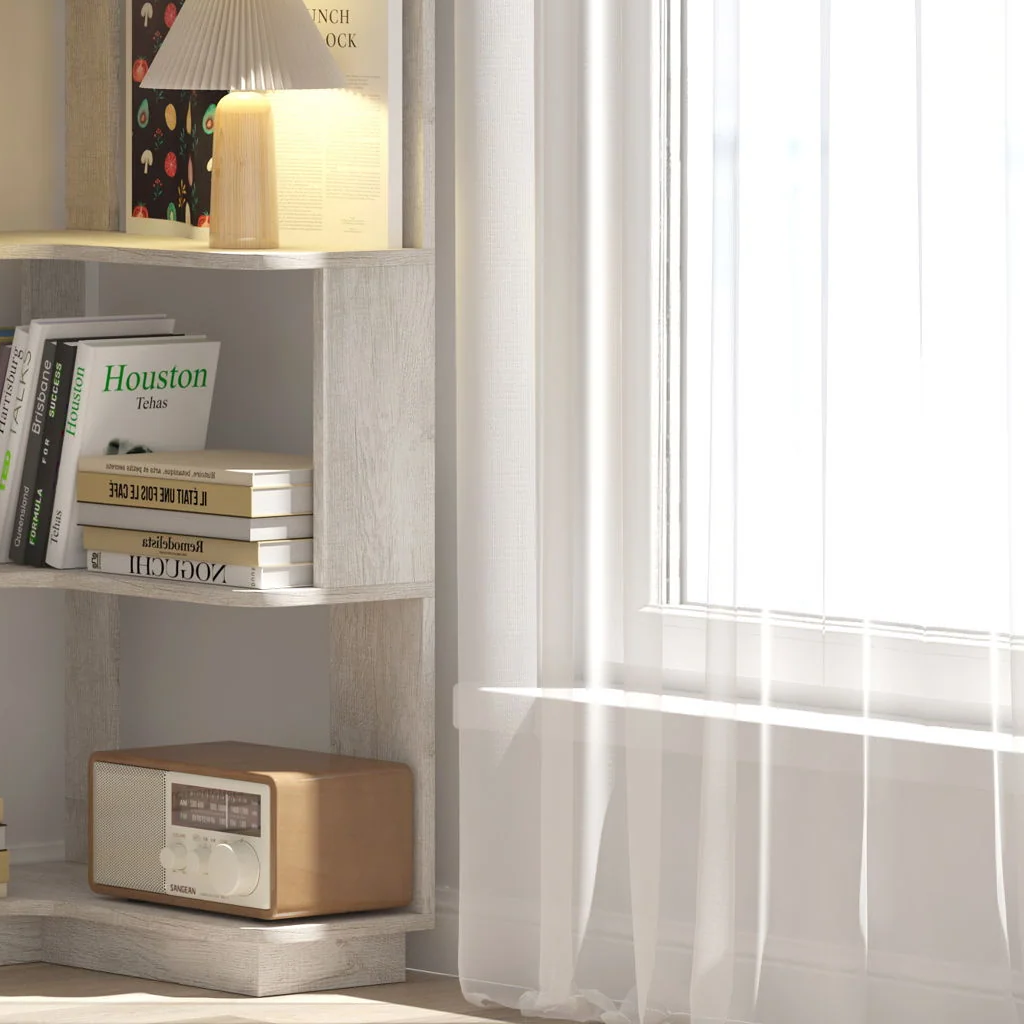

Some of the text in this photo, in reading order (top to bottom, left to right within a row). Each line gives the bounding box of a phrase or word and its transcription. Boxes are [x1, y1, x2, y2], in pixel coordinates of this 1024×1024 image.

[10, 350, 32, 434] TALKS
[31, 359, 52, 436] Brisbane
[65, 366, 85, 437] Houston
[102, 364, 208, 393] Houston
[136, 396, 168, 410] Tehas
[29, 362, 63, 546] FORMULA FOR SUCCESS
[14, 486, 30, 547] Queensland
[50, 510, 63, 544] Tehas
[170, 884, 196, 895] SANGEAN
